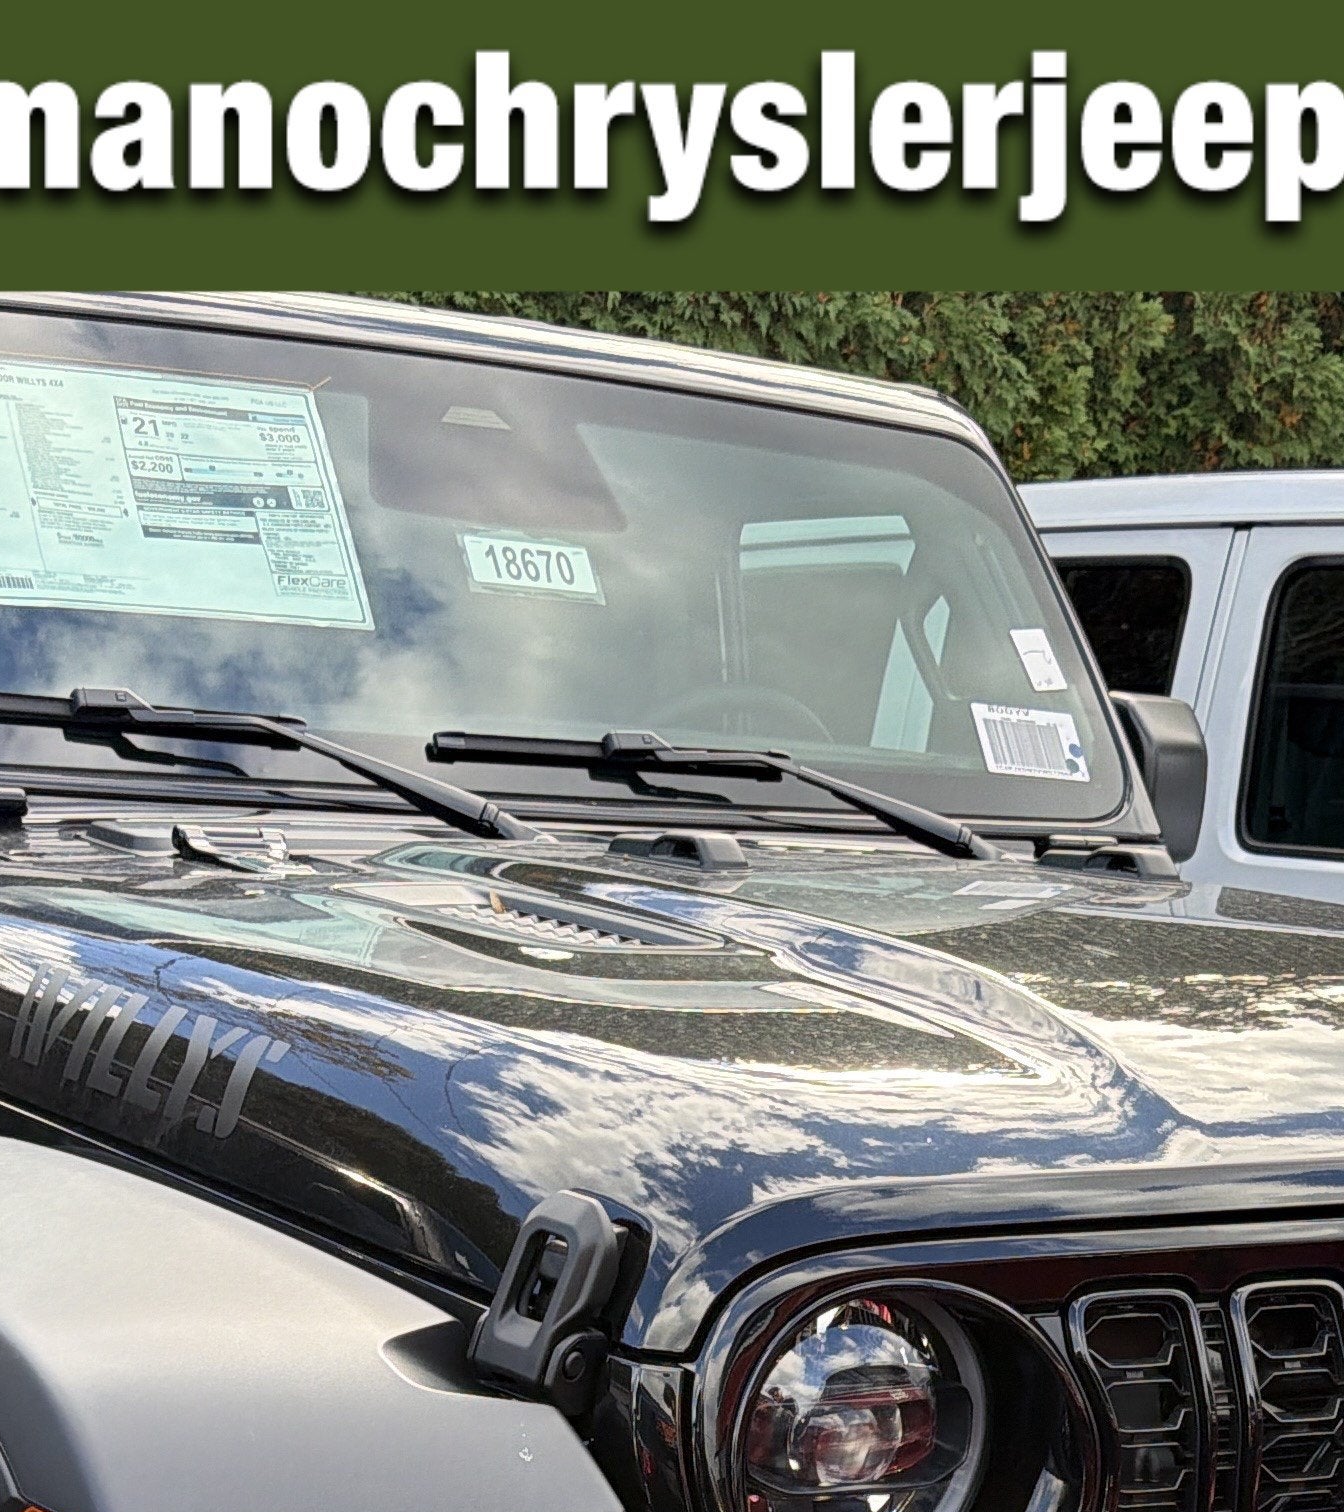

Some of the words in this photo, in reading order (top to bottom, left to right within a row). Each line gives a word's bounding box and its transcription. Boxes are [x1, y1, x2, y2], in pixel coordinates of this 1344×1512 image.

[16, 376, 47, 387] WILLYS
[132, 416, 159, 437] 21
[259, 432, 301, 443] $3,000
[130, 459, 174, 474] $2,200
[484, 544, 575, 586] 18670
[277, 575, 346, 588] FlexCare
[9, 962, 292, 1139] WILLYS
